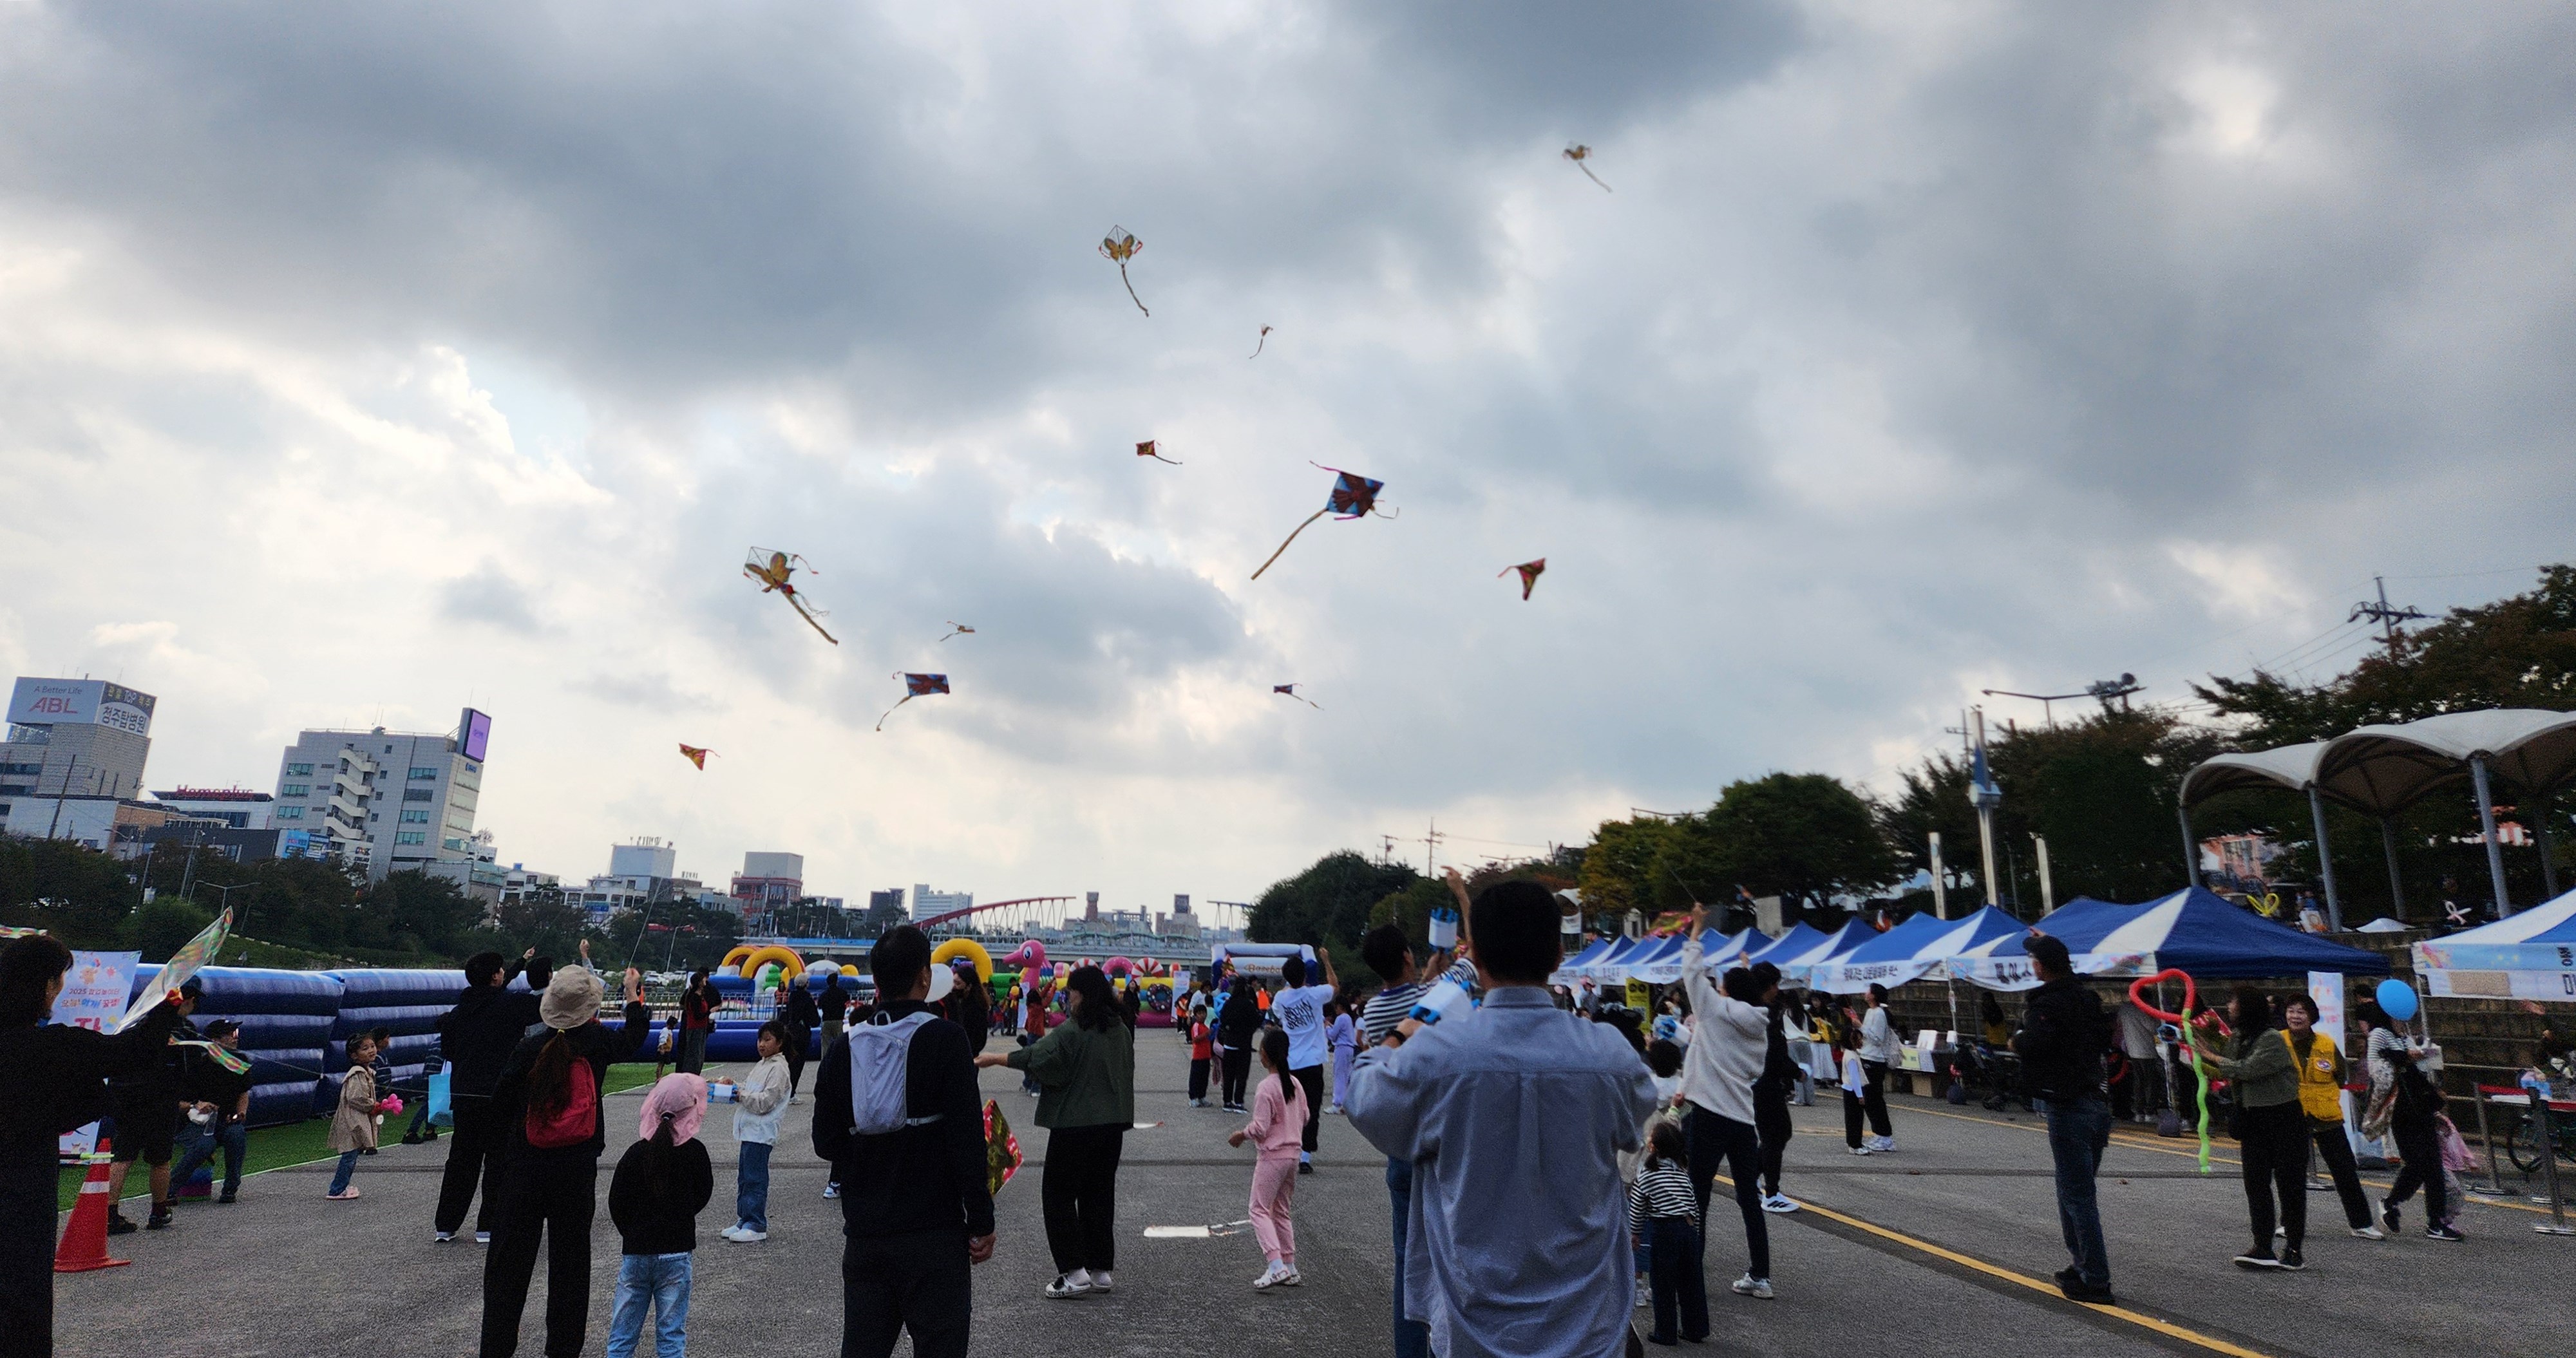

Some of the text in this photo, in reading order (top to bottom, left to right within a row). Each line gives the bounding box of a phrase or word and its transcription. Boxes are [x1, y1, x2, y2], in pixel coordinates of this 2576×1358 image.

[42, 686, 66, 694] Better
[68, 686, 82, 695] Life
[28, 697, 79, 714] ABL
[102, 705, 147, 733] 청주탑병원
[176, 784, 253, 800] Homeplus
[1244, 963, 1282, 974] Baseba
